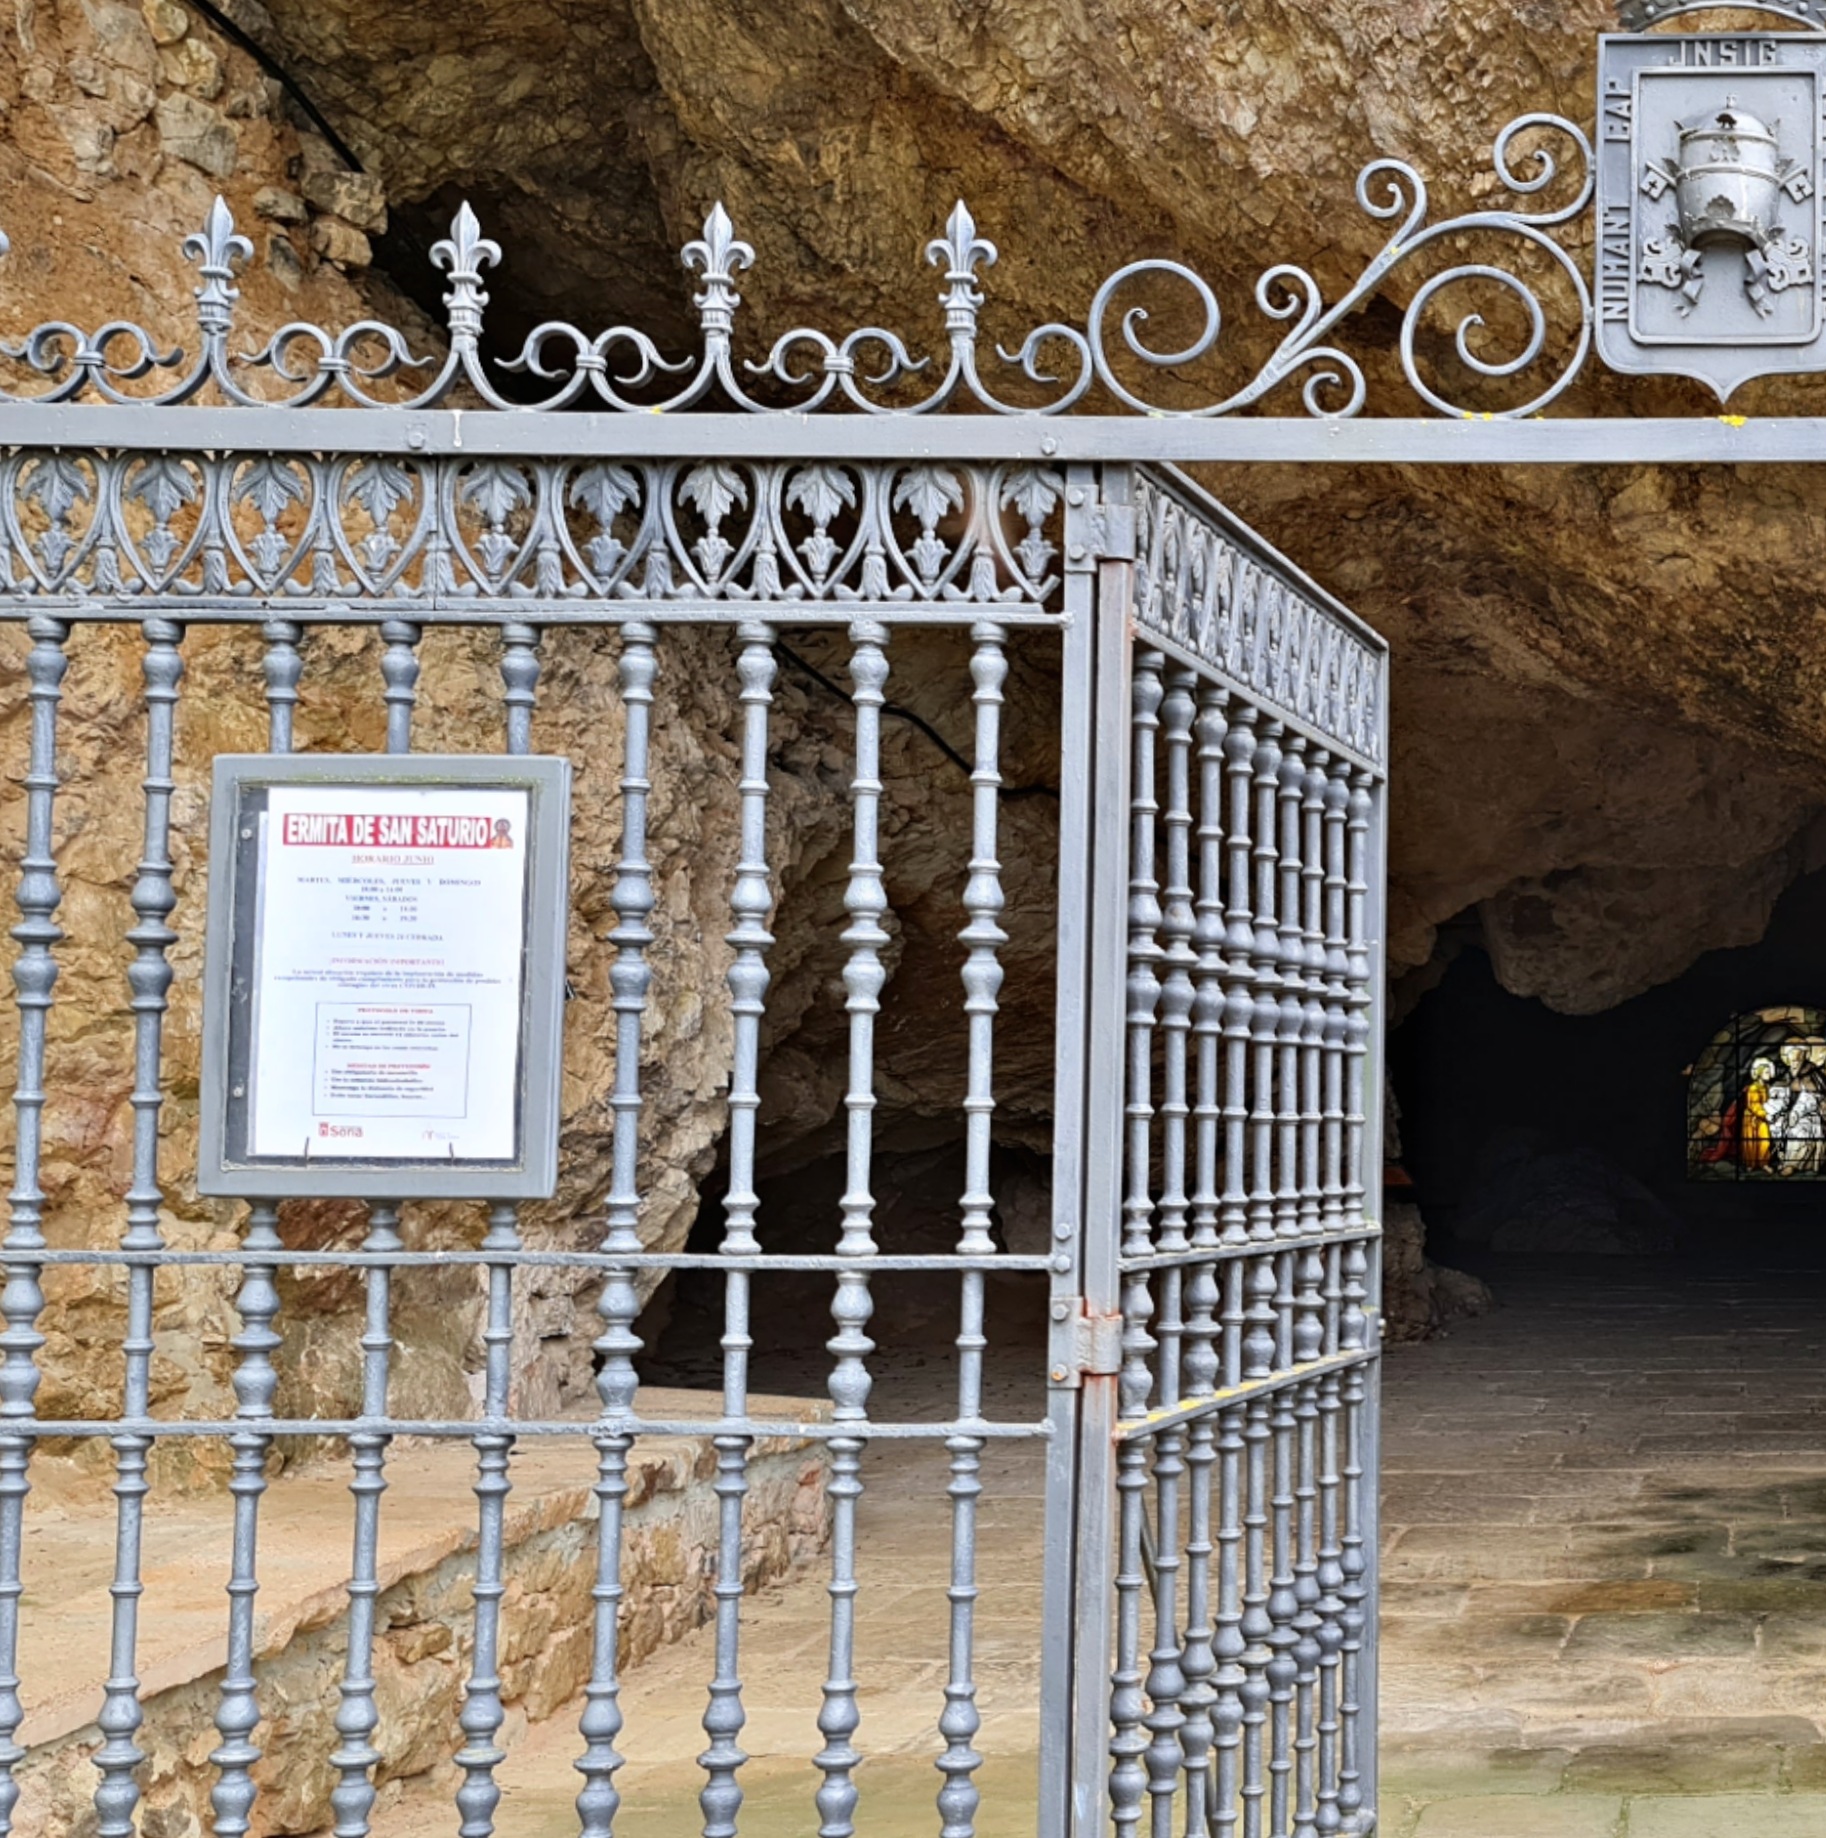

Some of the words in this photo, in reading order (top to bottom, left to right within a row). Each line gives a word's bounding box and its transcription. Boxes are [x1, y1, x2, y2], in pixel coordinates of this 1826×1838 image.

[1602, 204, 1630, 323] NUMANT
[287, 814, 348, 844] ERMITA
[352, 815, 376, 845] DE
[378, 816, 413, 846] SAN
[416, 817, 489, 848] SATURIO
[351, 855, 401, 865] HORARIO
[403, 855, 435, 866] JUNIO
